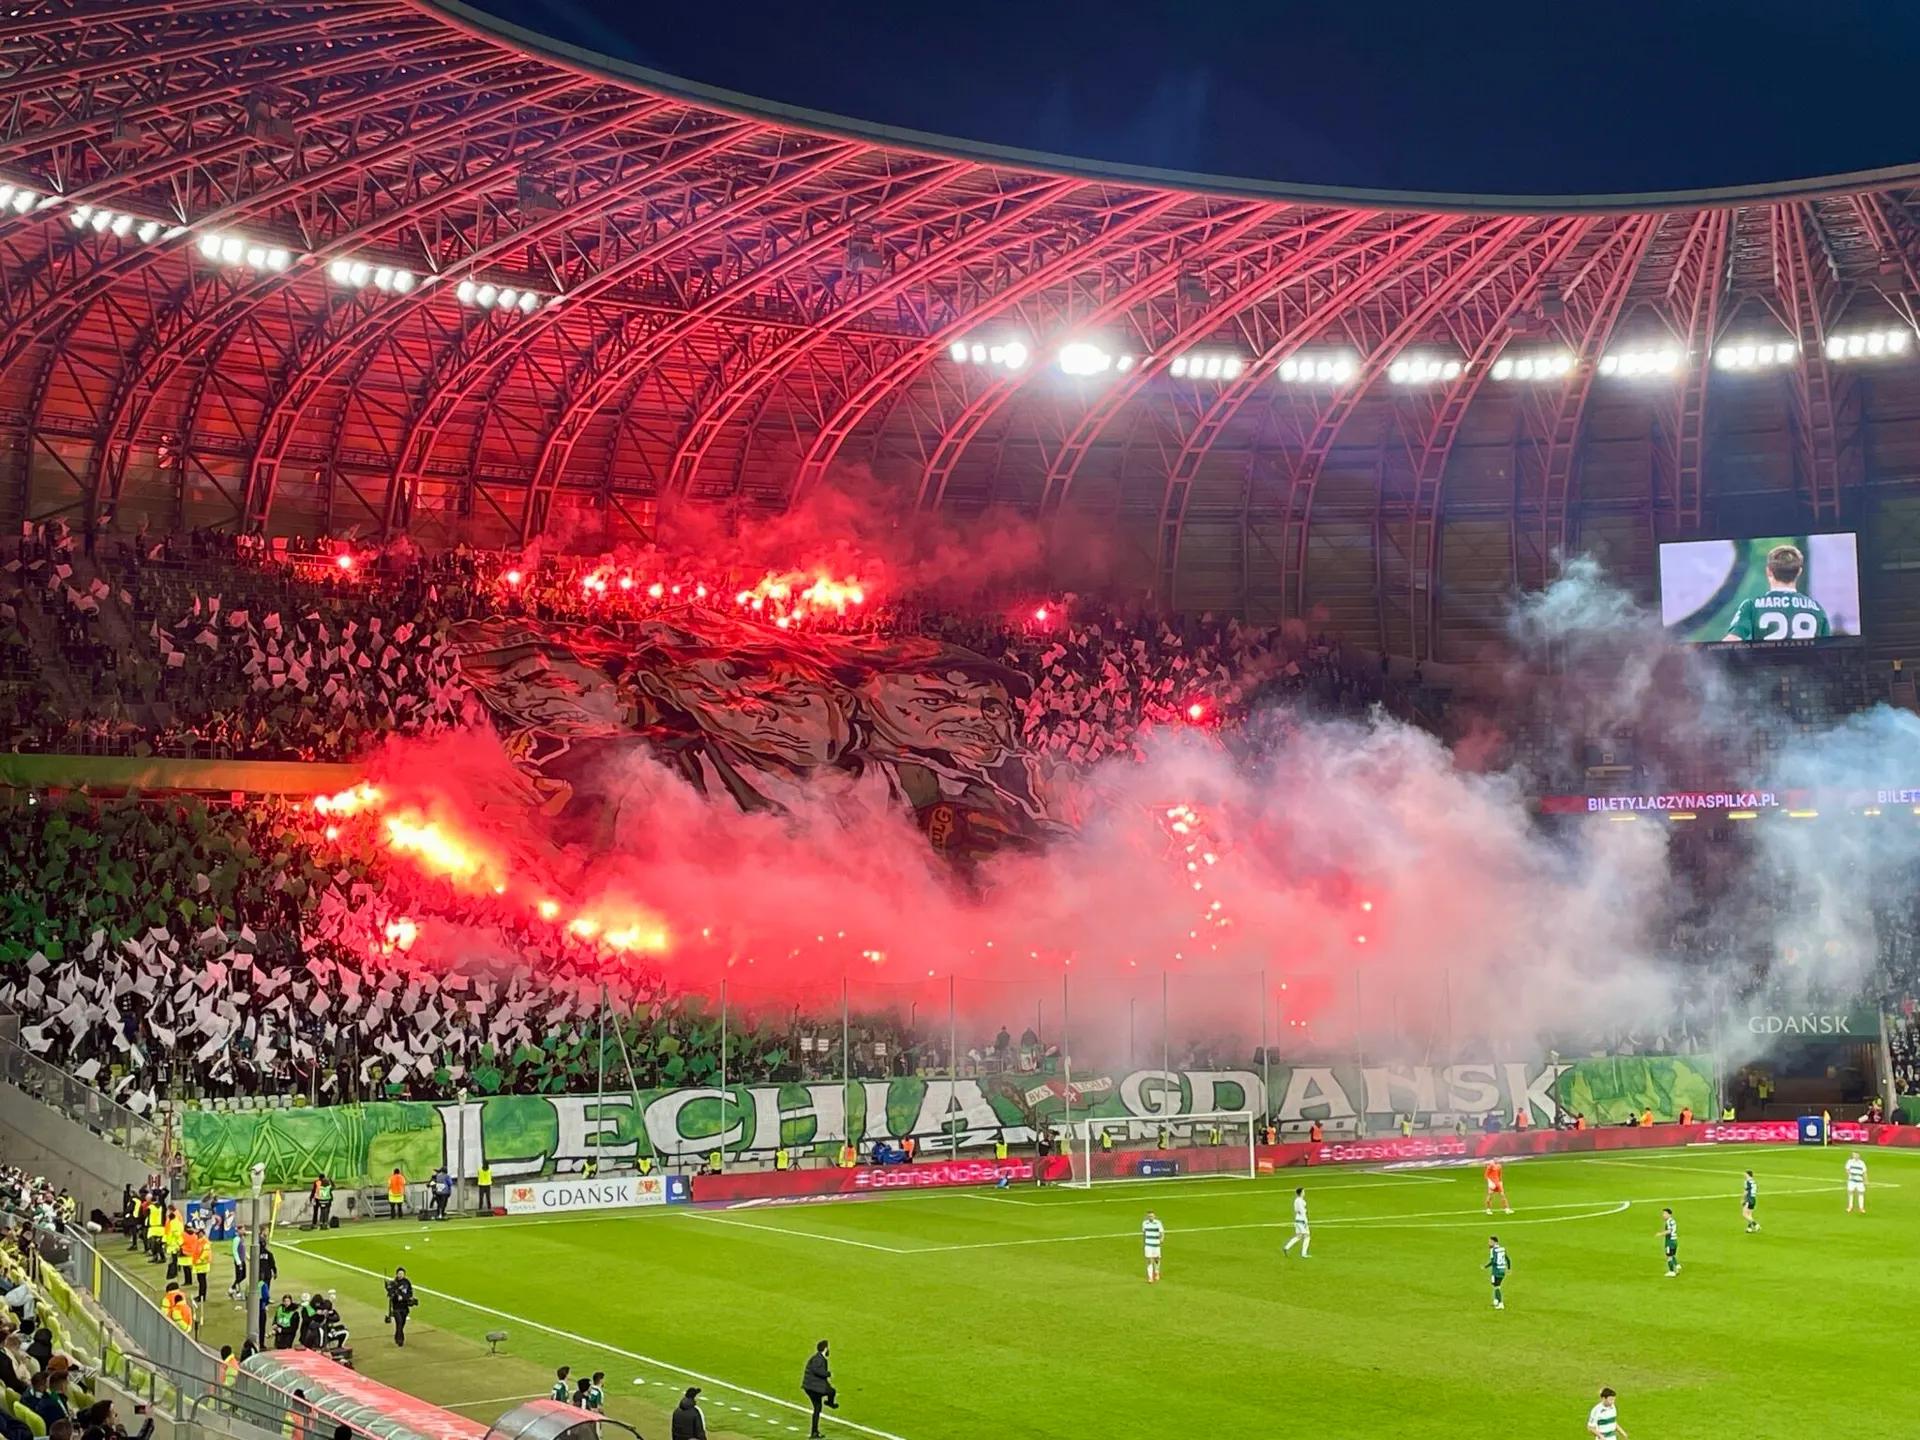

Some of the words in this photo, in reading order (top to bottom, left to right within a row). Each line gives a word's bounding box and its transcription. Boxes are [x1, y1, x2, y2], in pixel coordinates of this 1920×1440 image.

[1755, 596, 1789, 608] MARC
[1588, 792, 1779, 812] BILETY.LACZYNASPILKA.PL
[1749, 1012, 1850, 1034] GDAŃSK
[1028, 1087, 1052, 1102] BKS
[434, 1078, 1004, 1179] LECHIA
[542, 1183, 629, 1207] GDAŃSK
